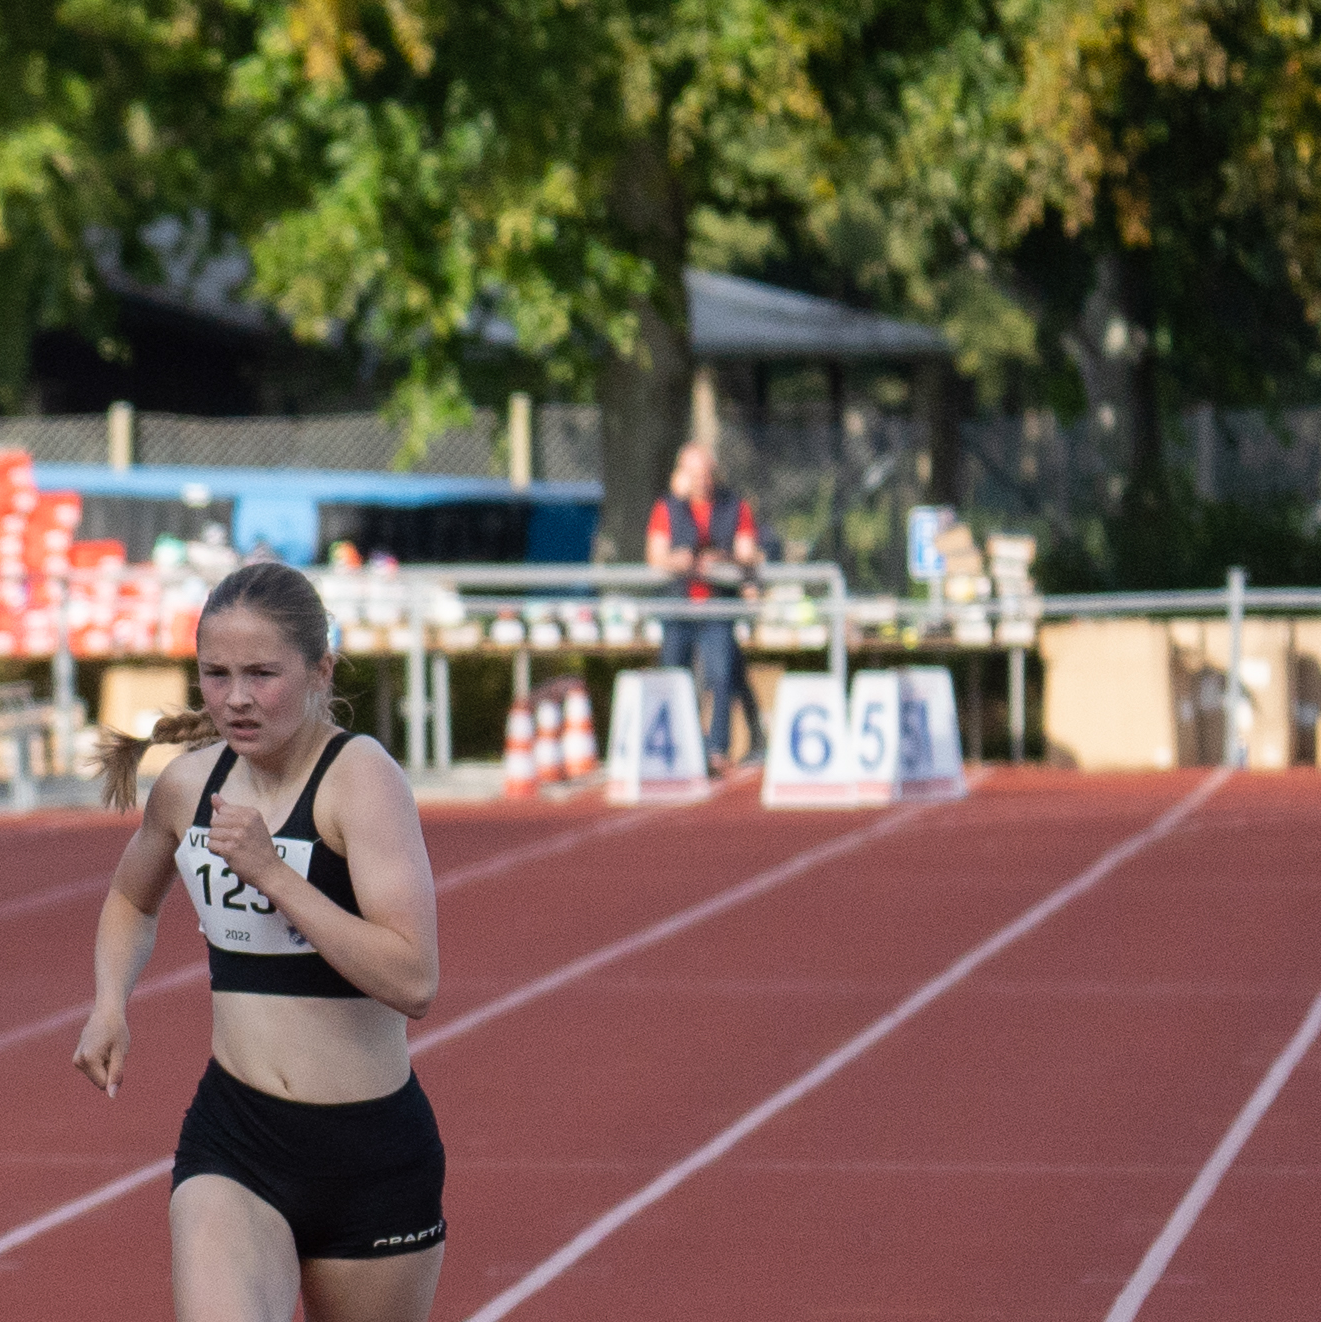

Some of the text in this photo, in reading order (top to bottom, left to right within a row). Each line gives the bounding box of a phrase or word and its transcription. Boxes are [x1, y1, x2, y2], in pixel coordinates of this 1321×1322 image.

[642, 700, 676, 770] 4
[789, 704, 834, 774] 6
[859, 703, 886, 772] 5
[225, 929, 251, 942] 2022
